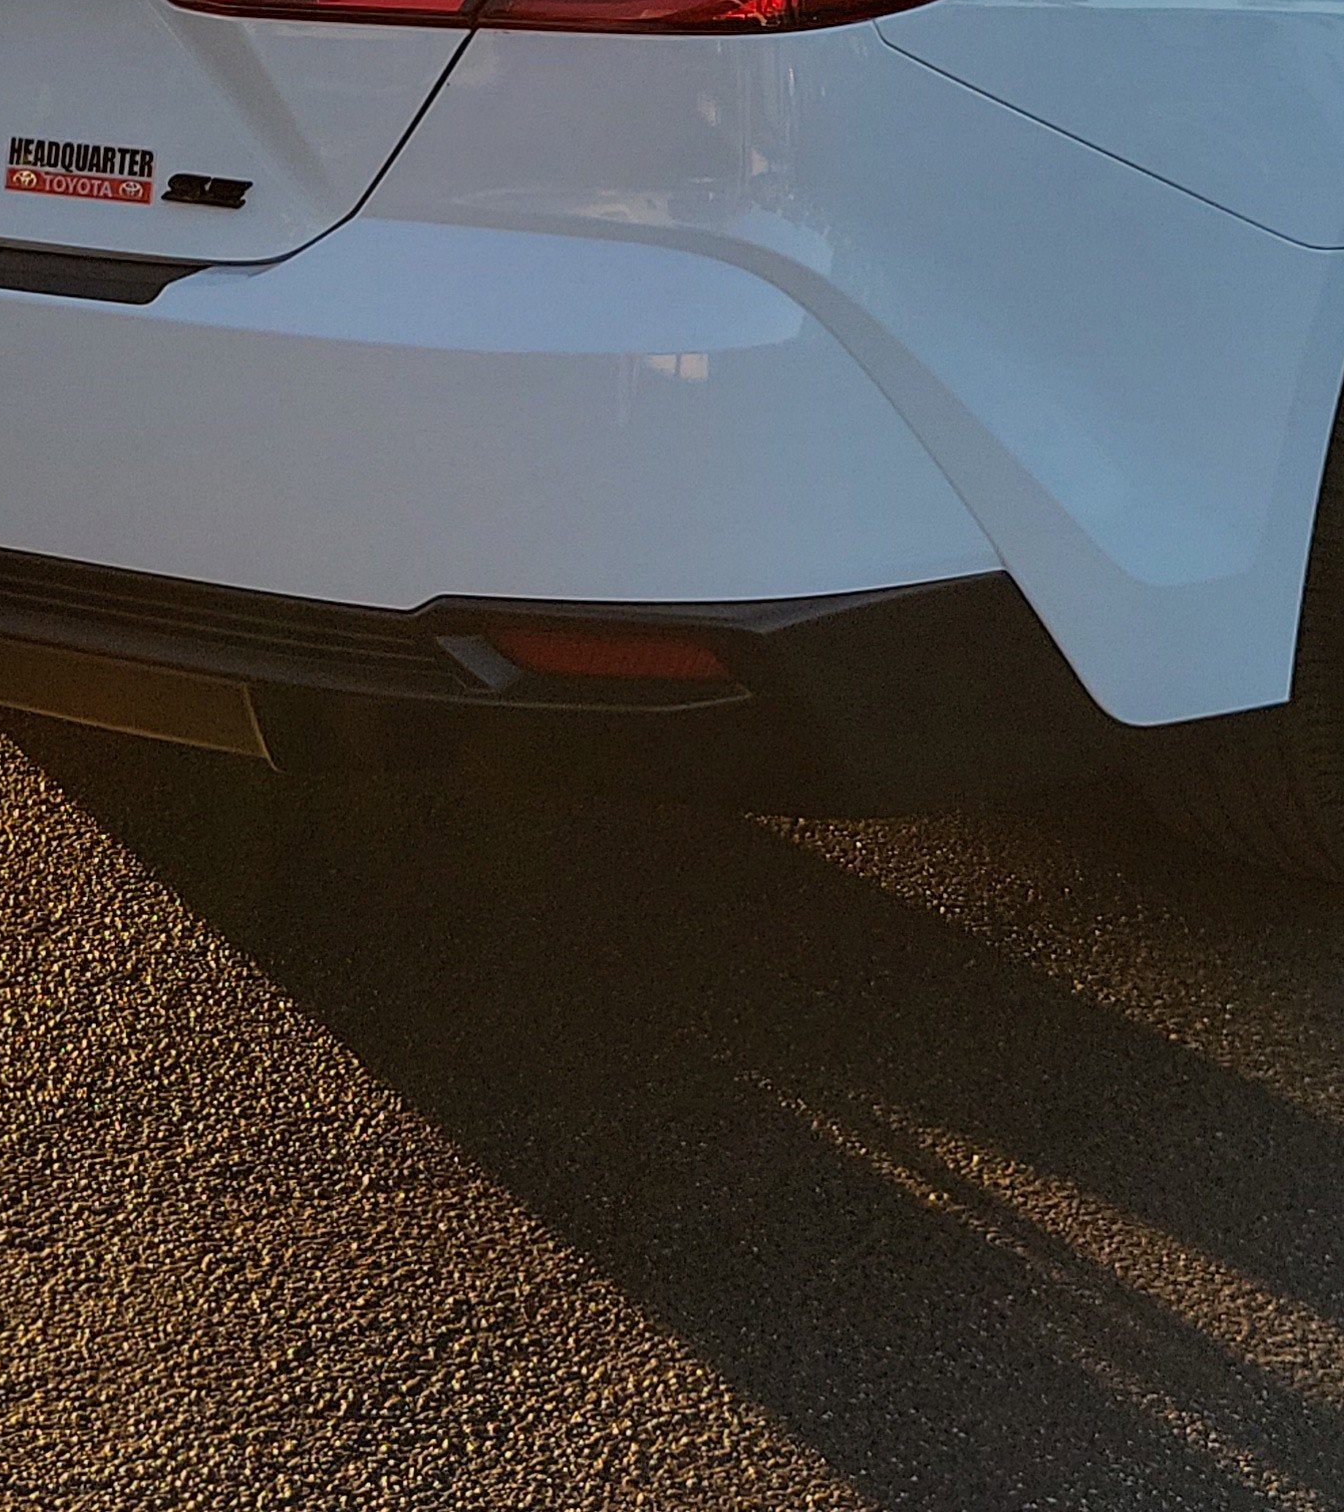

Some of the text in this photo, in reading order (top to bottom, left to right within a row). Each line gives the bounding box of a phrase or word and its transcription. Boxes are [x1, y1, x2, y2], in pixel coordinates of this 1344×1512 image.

[8, 136, 154, 178] HEADQUARTER
[42, 173, 113, 198] TOYOTA
[161, 172, 253, 209] SE
